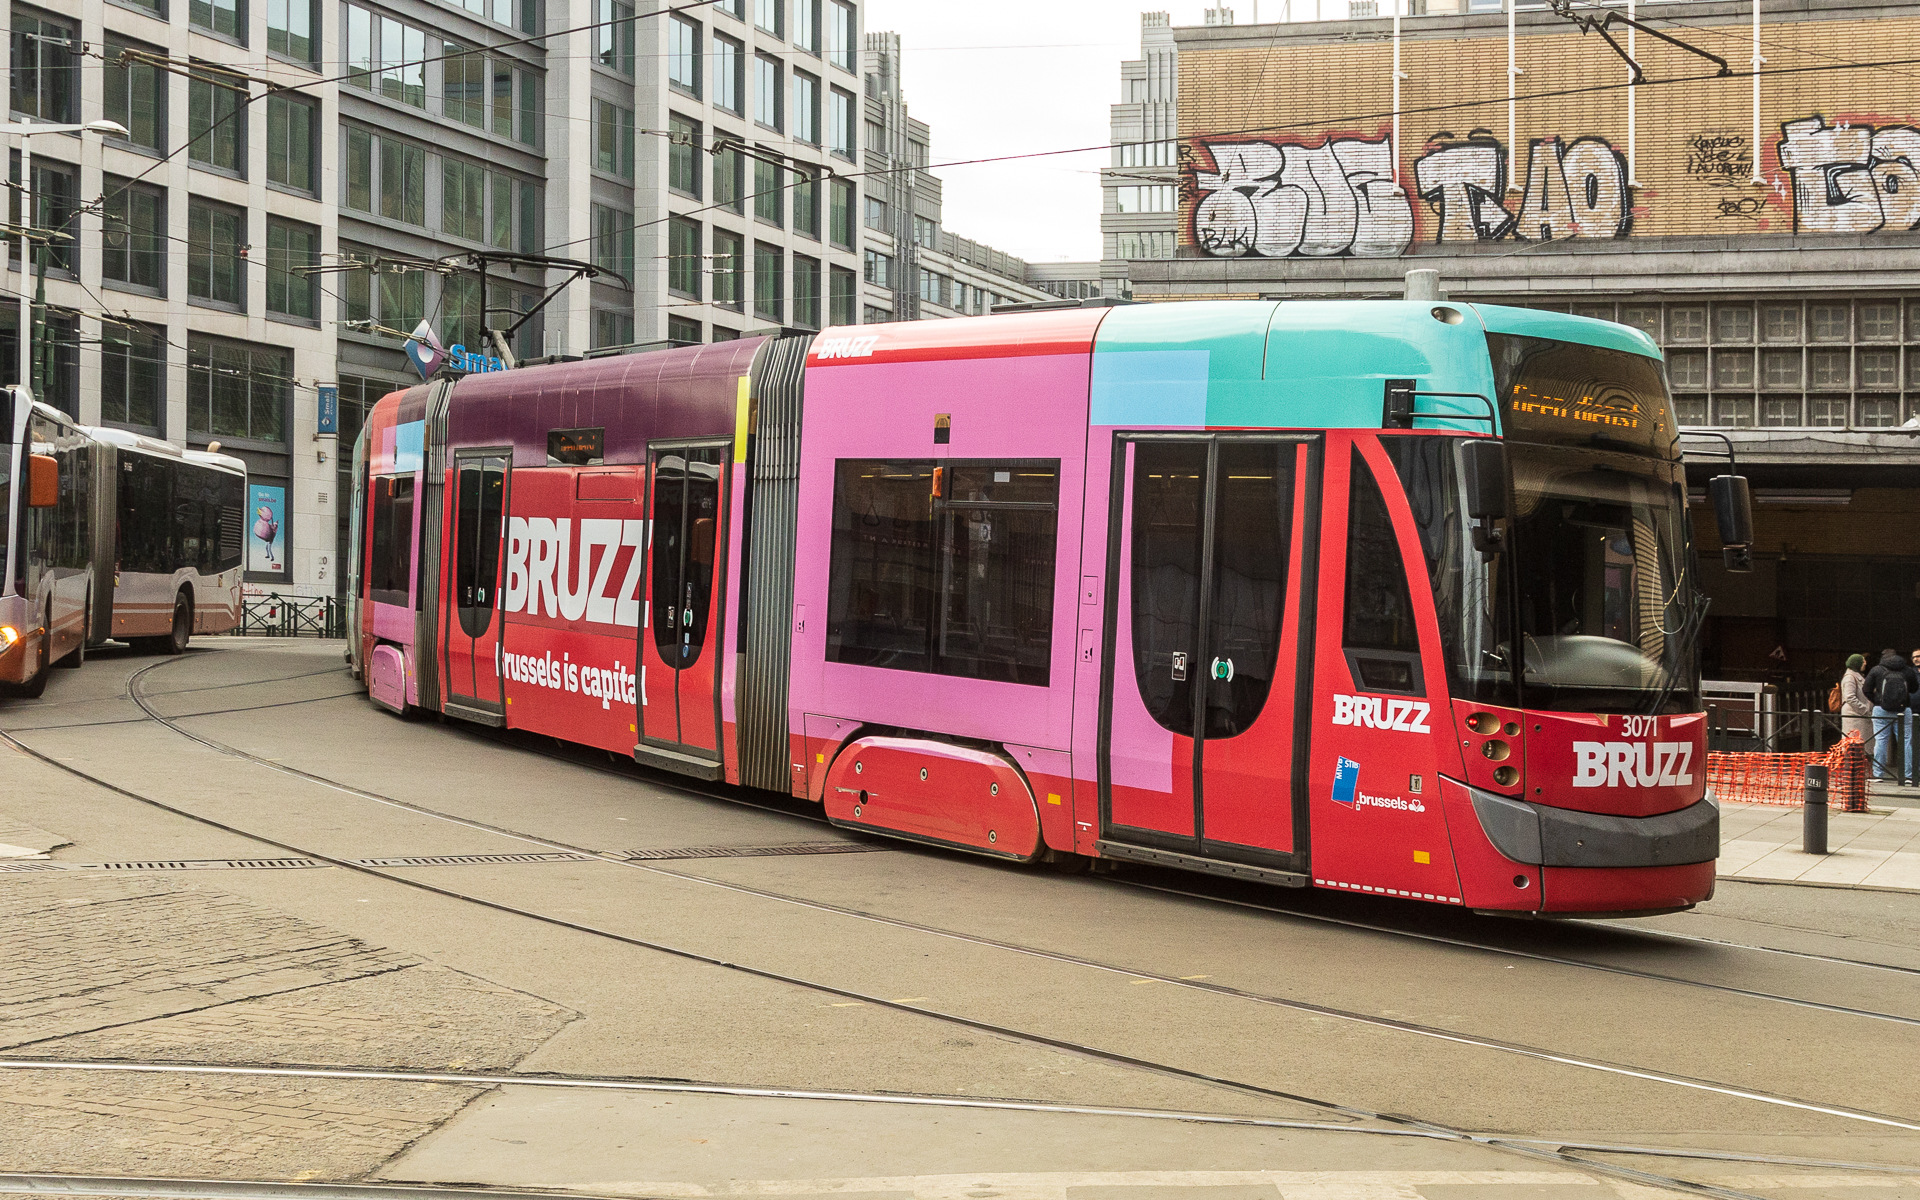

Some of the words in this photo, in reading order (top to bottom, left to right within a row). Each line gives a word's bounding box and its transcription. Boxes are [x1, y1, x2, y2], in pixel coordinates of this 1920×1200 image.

[817, 335, 880, 360] BRUZZ
[498, 516, 653, 629] BRUZZ
[563, 651, 579, 693] is
[580, 660, 648, 710] capital
[1332, 694, 1431, 734] BRUZZ
[1621, 715, 1658, 738] 3071
[1344, 759, 1359, 769] STIB
[1572, 741, 1693, 788] BRUZZ
